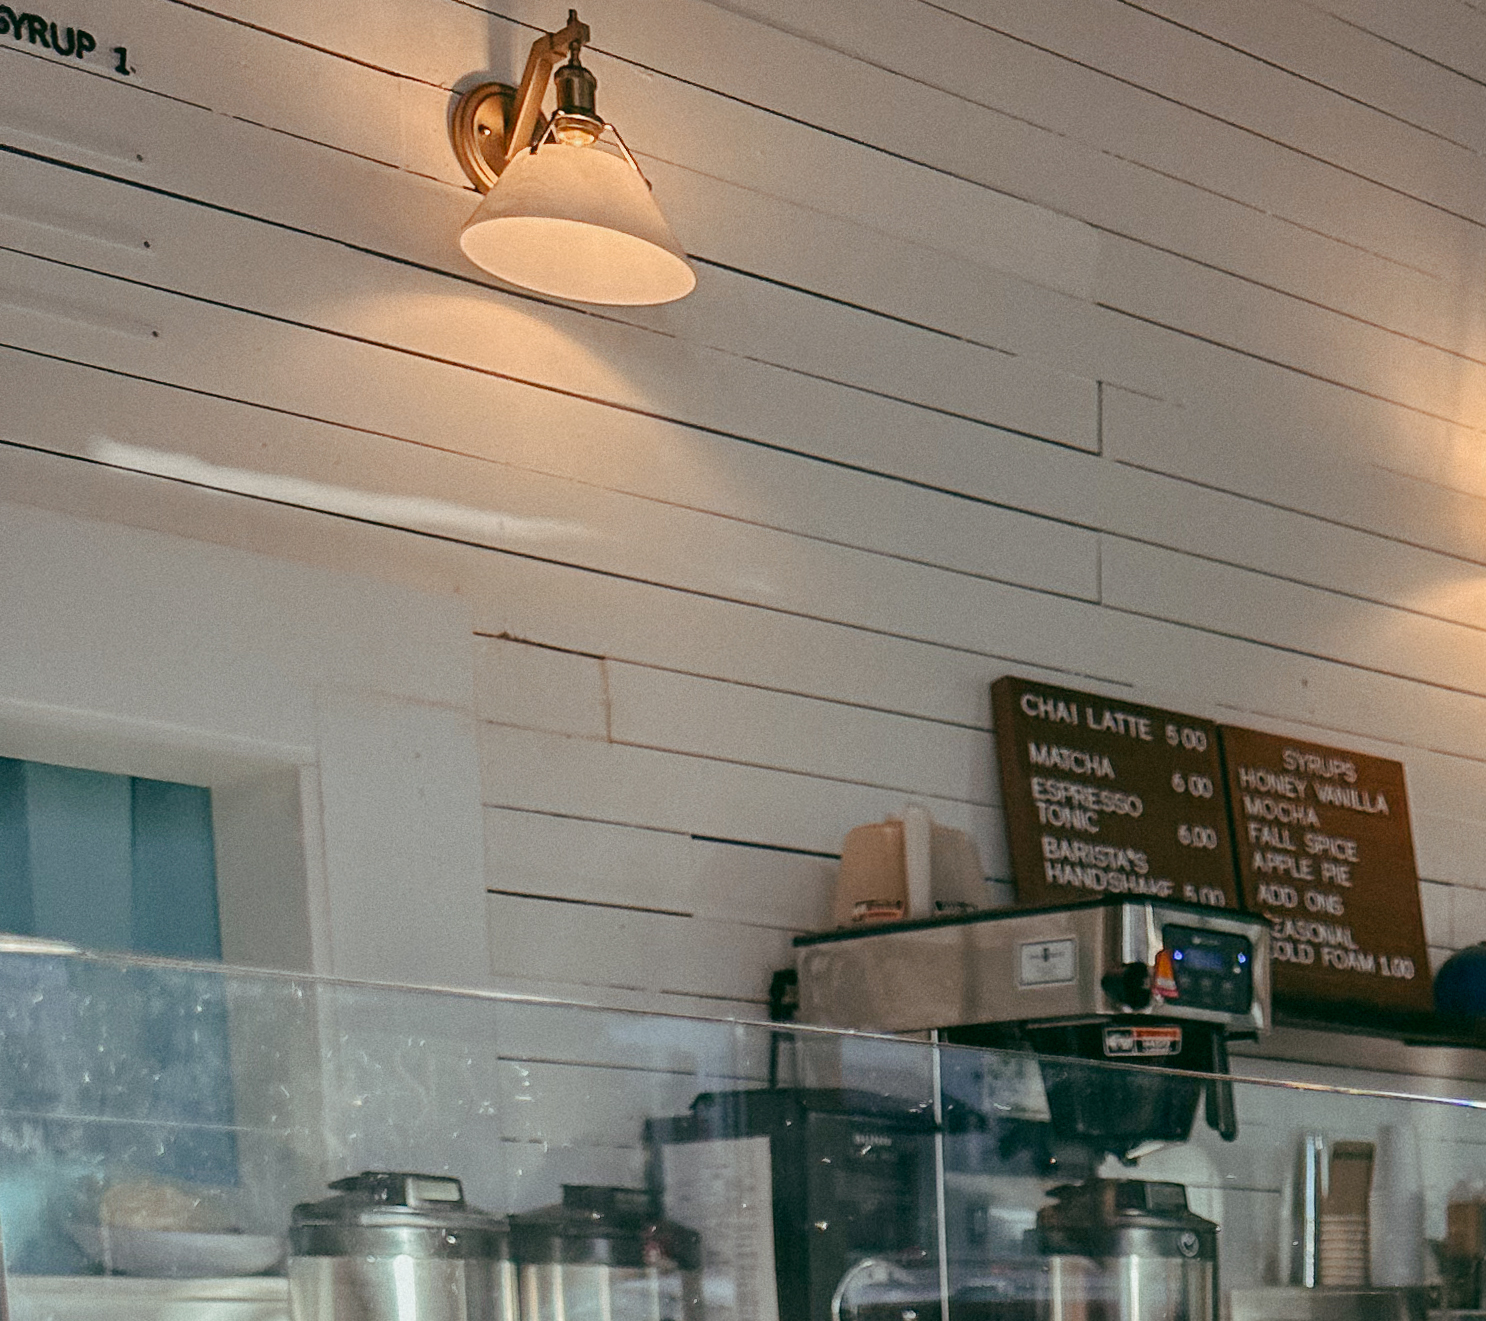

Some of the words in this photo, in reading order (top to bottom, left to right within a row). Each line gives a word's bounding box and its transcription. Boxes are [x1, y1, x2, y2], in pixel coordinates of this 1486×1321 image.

[0, 4, 97, 59] SYRUP
[1020, 693, 1078, 725] CHAI
[1086, 707, 1153, 741] LATTE
[1028, 741, 1115, 779] MATCHA
[1282, 748, 1358, 784] SYRUPS
[1031, 776, 1144, 818] ESPRESSO
[1238, 766, 1307, 798] HONEY
[1312, 780, 1389, 816] VANILLA
[1035, 801, 1100, 834] TONIC
[1243, 794, 1320, 828] MOCHA
[1041, 835, 1149, 874] BARISTA'S
[1248, 820, 1297, 850] FALL
[1303, 831, 1360, 863] SPICE
[1253, 849, 1315, 881] APPLE
[1321, 861, 1353, 888] PIE
[1271, 916, 1359, 950] EASONAL
[1320, 946, 1376, 974] FOAM
